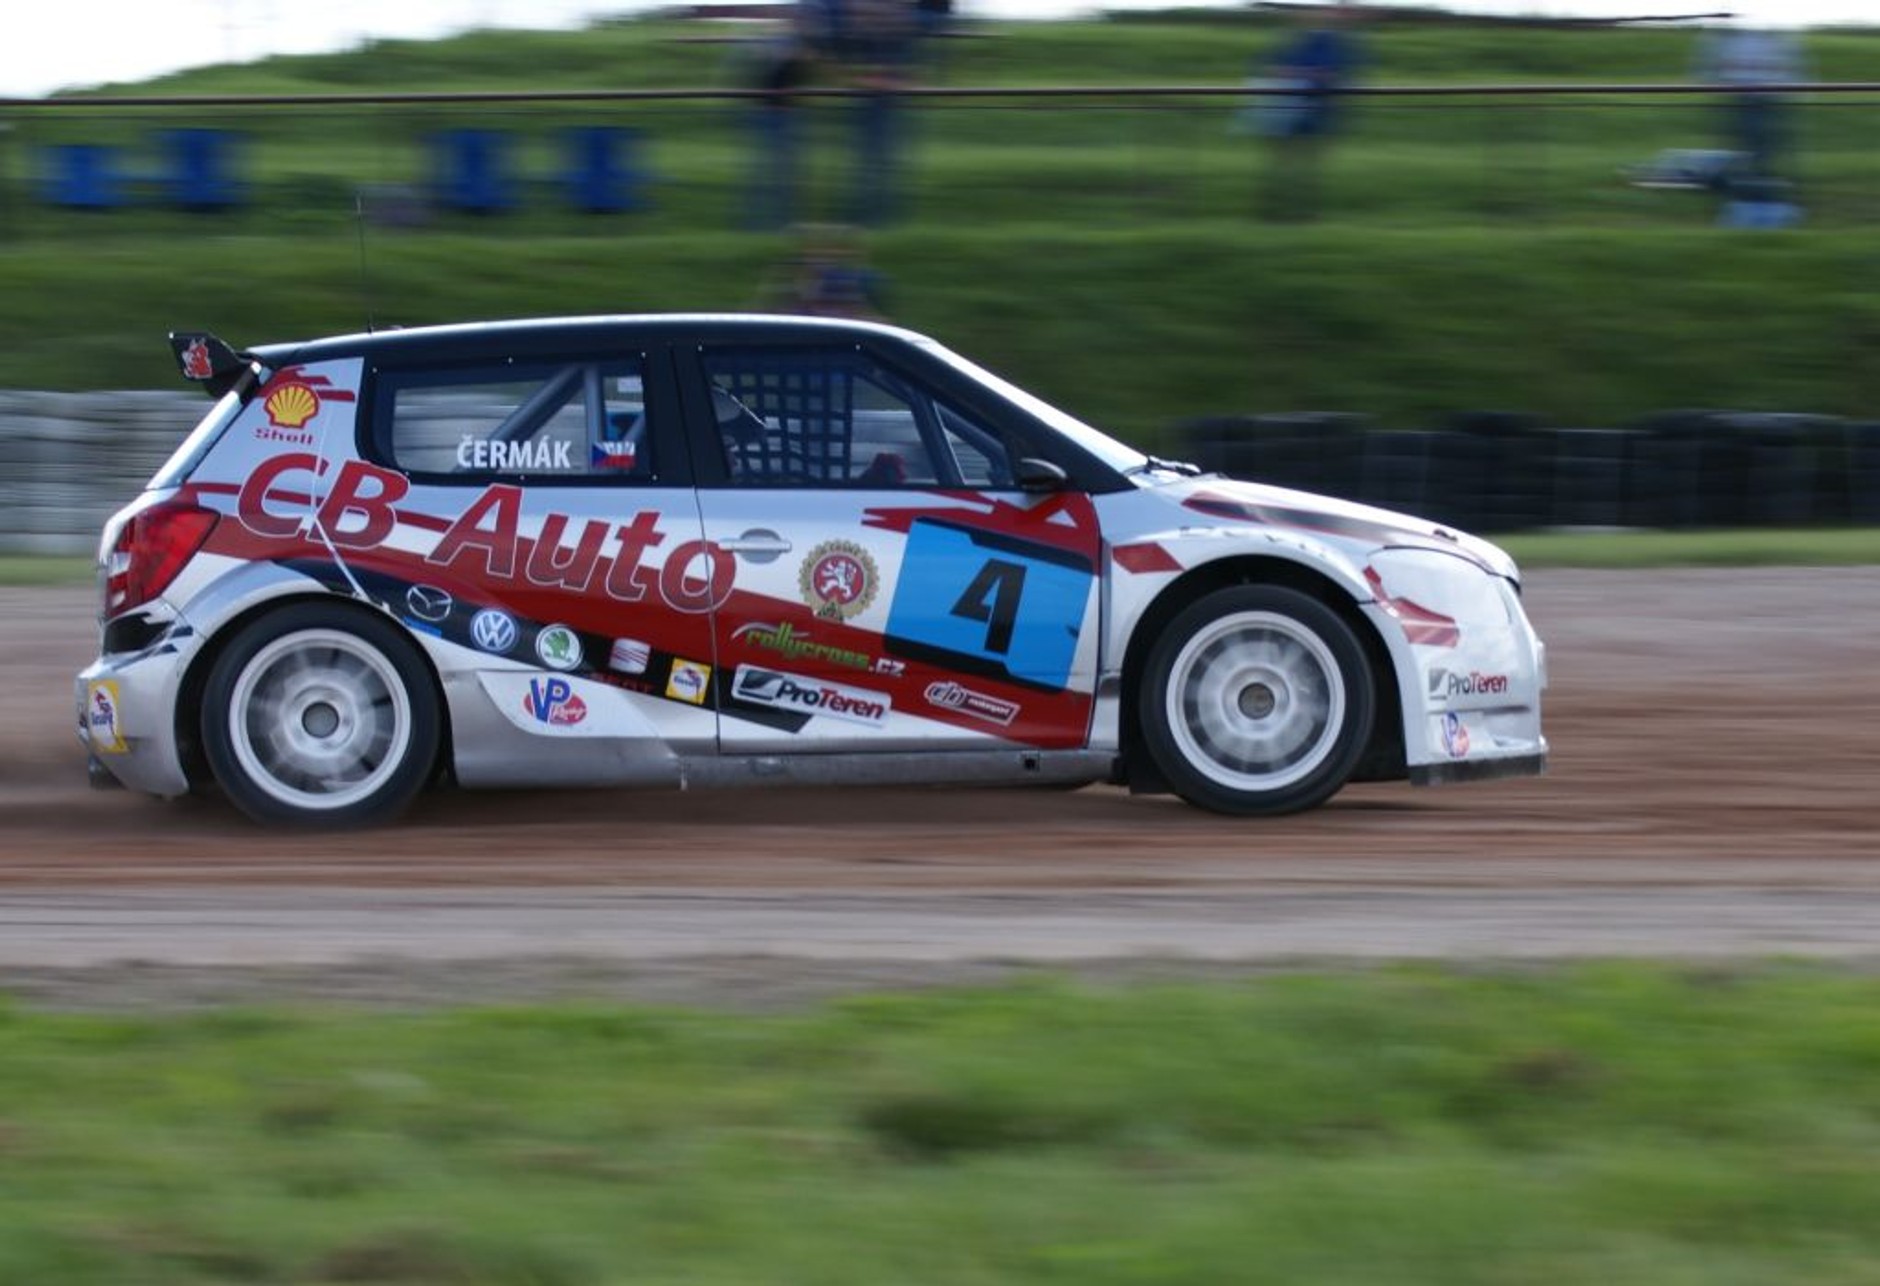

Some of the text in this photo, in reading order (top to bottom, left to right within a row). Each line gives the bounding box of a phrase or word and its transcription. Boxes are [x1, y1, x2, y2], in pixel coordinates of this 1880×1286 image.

[254, 427, 314, 446] Shell
[456, 434, 573, 470] ČERMÁK
[237, 452, 737, 614] CB Auto
[949, 558, 1027, 655] 4
[530, 677, 571, 723] VP
[775, 680, 885, 720] ProTeren
[1447, 671, 1507, 696] ProTeren
